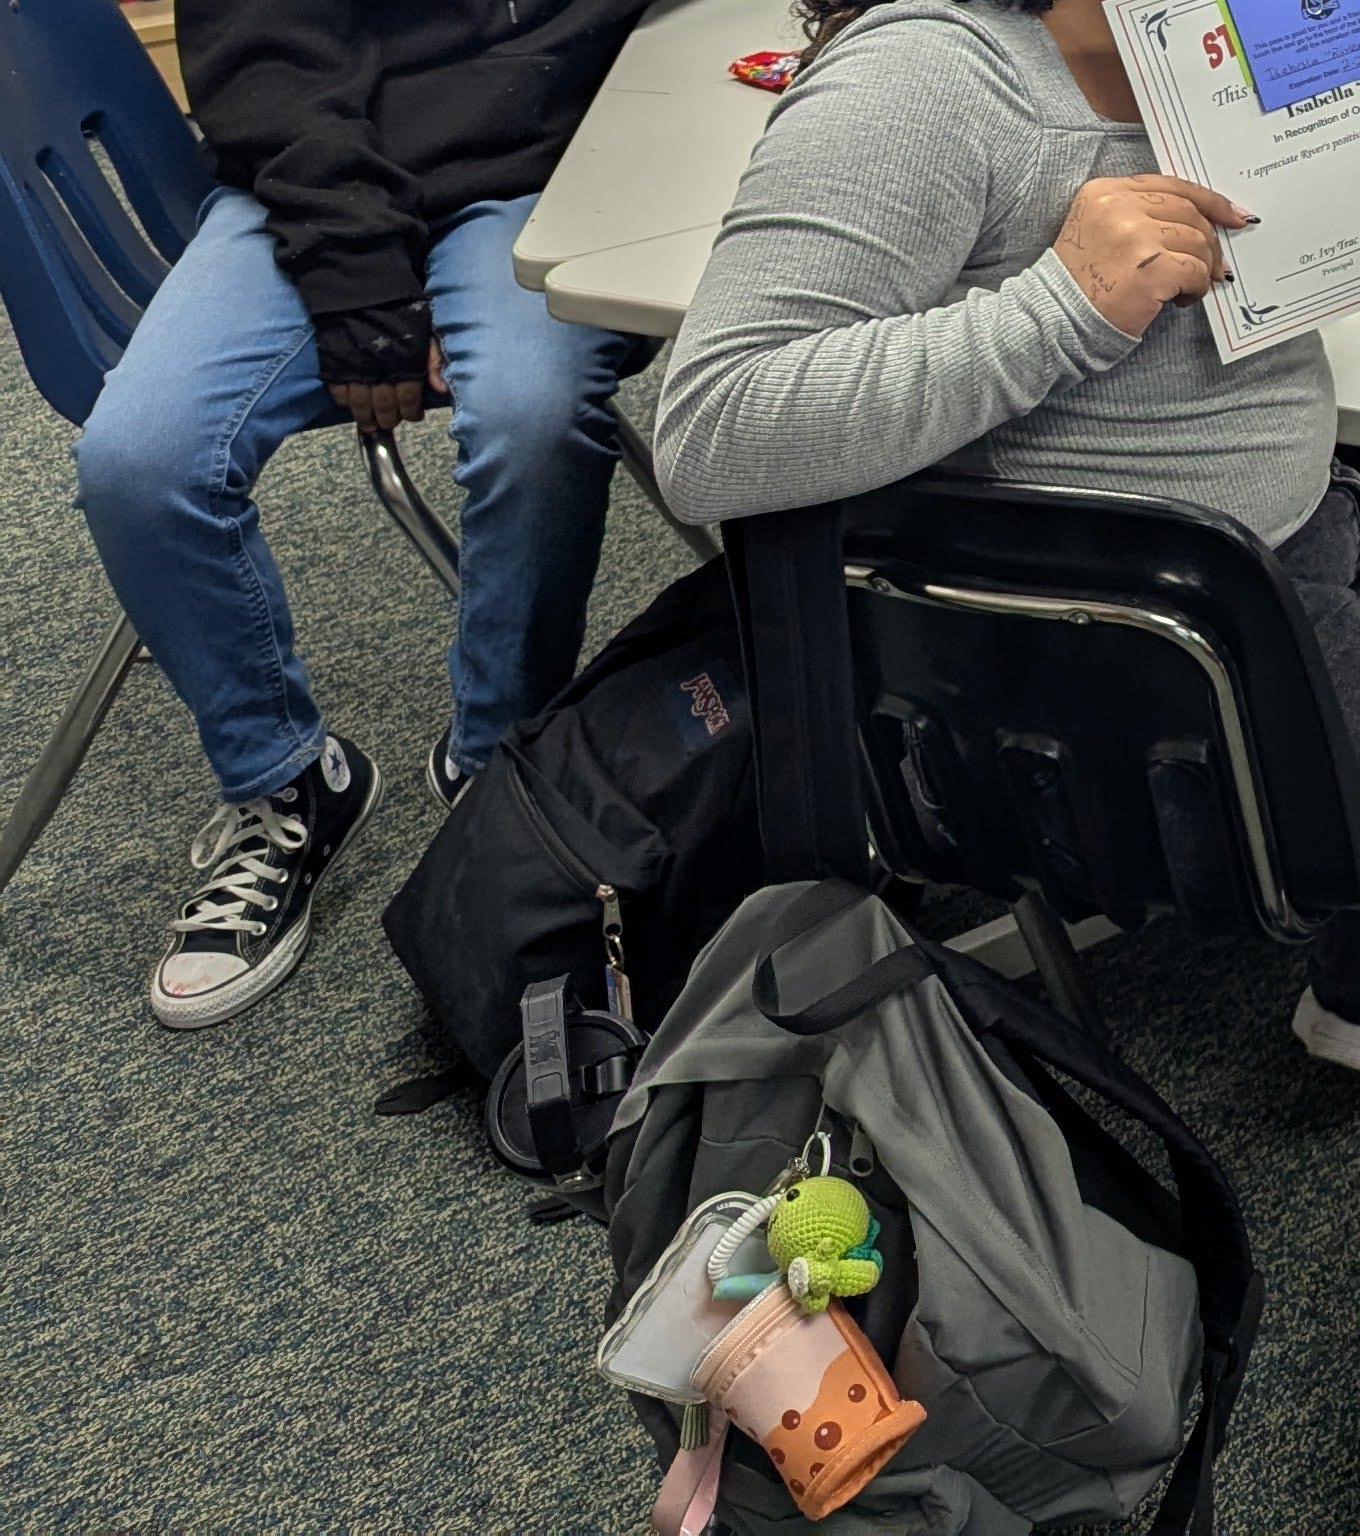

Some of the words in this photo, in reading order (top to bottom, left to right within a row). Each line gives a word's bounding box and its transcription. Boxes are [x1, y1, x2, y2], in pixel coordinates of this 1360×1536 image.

[1212, 84, 1249, 107] This
[1282, 87, 1355, 119] Isabella
[1272, 134, 1284, 143] In
[1284, 114, 1340, 140] Recognition
[1340, 108, 1351, 120] of
[1246, 168, 1252, 179] I
[1253, 154, 1299, 178] appreciate
[1300, 142, 1331, 160] River's
[1299, 253, 1317, 265] Dr.
[1318, 245, 1336, 259] Ivy
[1336, 236, 1359, 251] Trac
